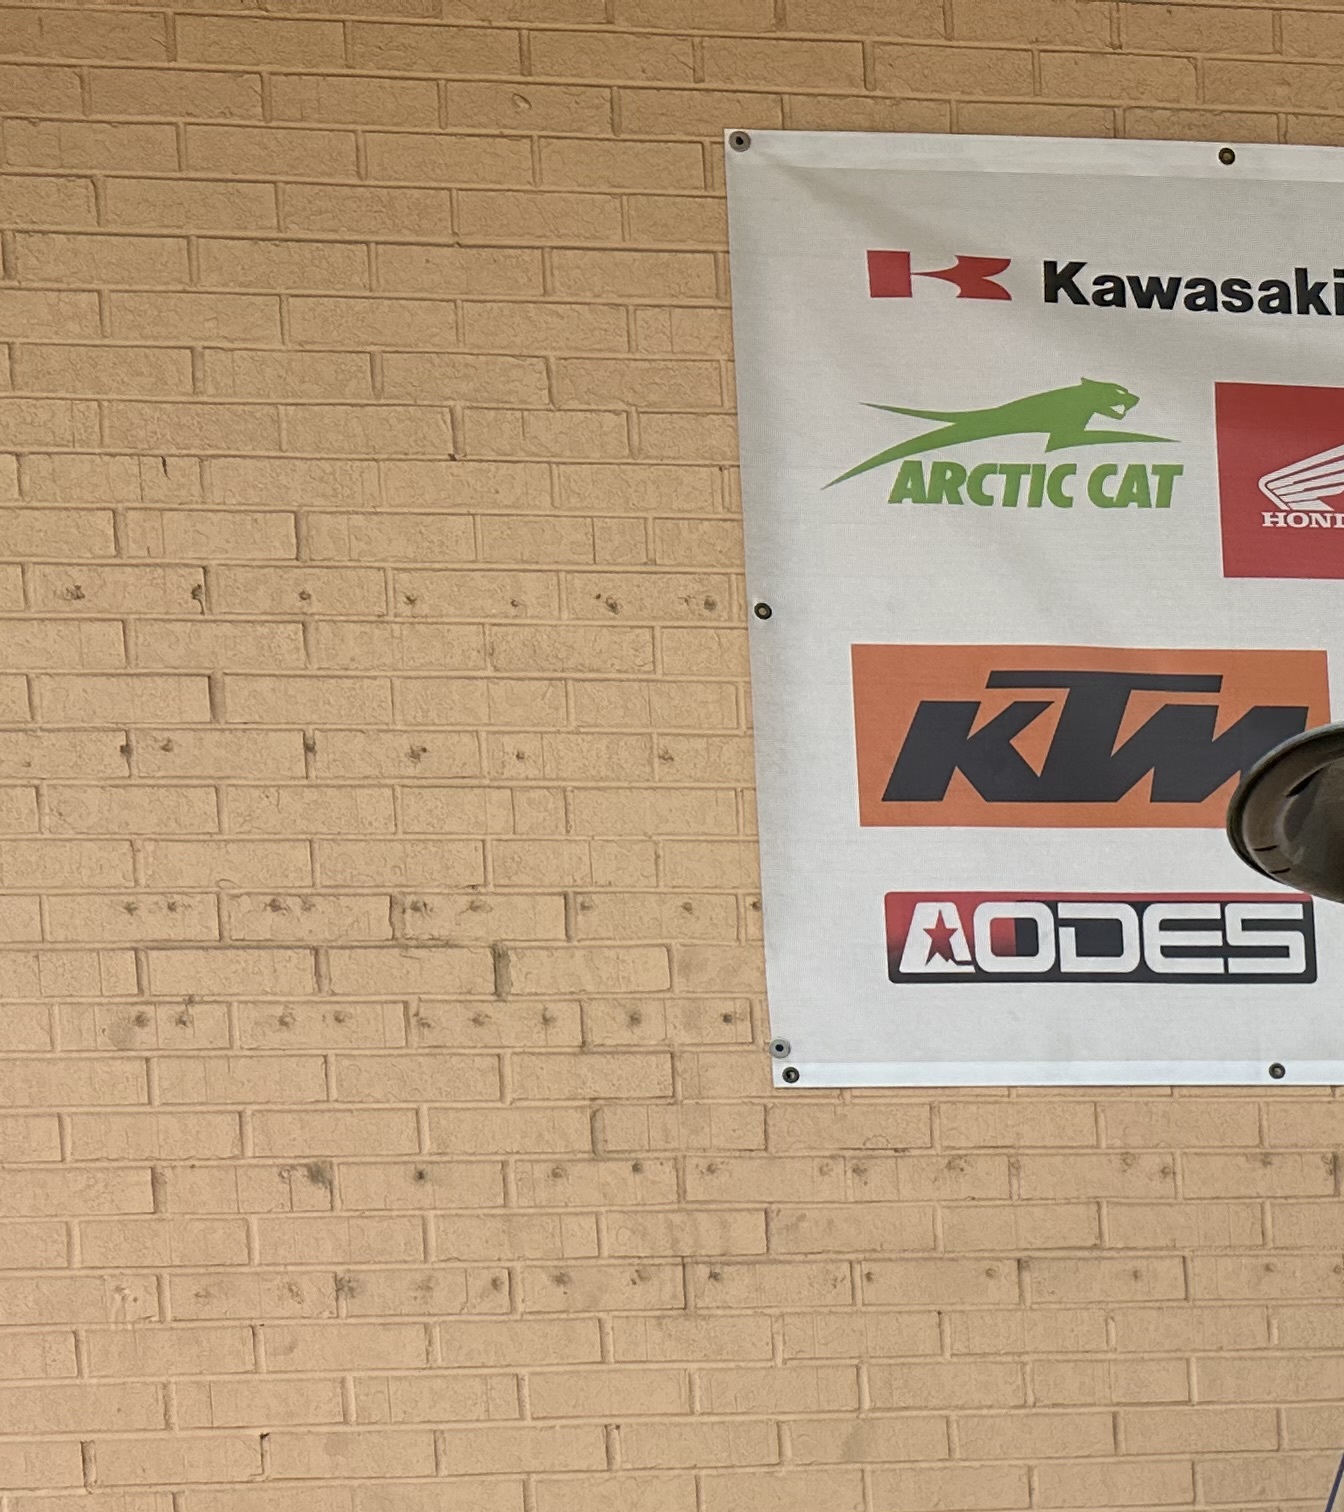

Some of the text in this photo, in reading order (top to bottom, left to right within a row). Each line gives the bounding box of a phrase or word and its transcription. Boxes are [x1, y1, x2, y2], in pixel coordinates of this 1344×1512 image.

[887, 459, 1185, 510] ARCTIC CAT
[881, 670, 1309, 803] KTM
[898, 901, 1307, 975] AODES
